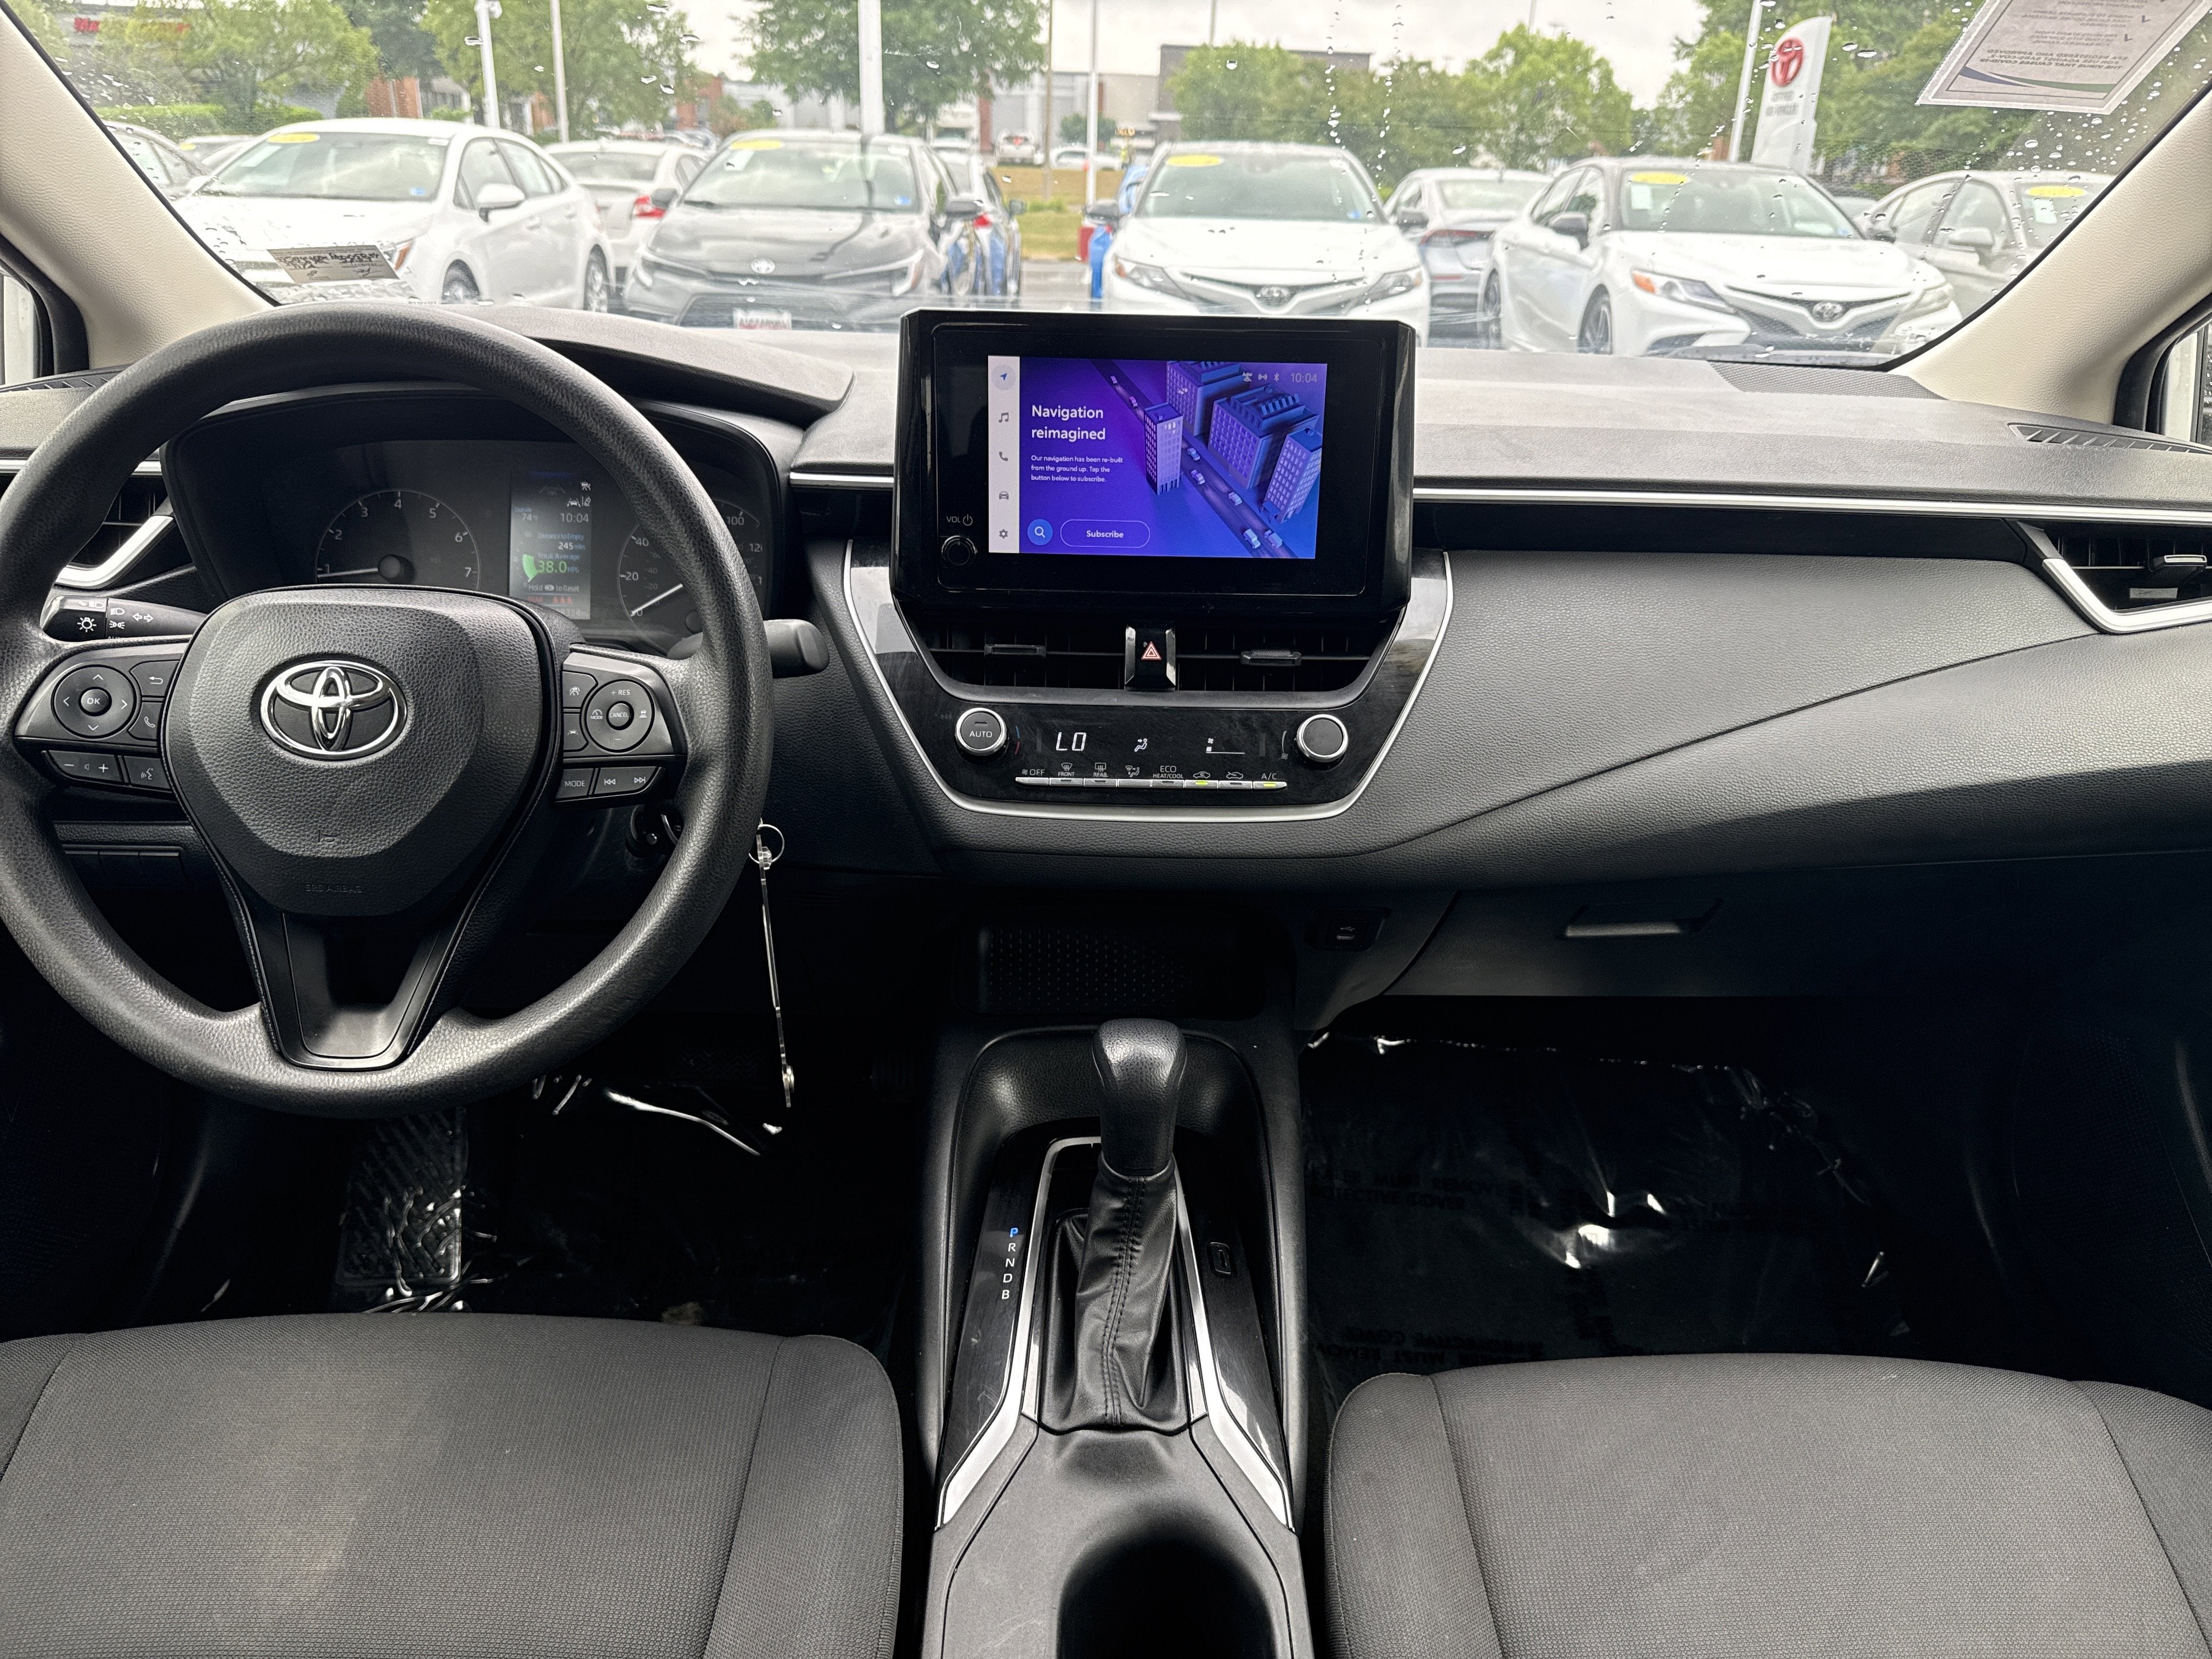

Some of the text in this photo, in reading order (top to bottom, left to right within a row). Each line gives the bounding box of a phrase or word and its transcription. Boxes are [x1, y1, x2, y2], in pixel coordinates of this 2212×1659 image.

[1290, 373, 1317, 382] 10:04
[1032, 405, 1104, 421] Navigation
[1031, 426, 1106, 442] reimagined
[394, 499, 402, 509] 4
[360, 508, 368, 517] 3
[429, 508, 437, 518] 5
[561, 513, 589, 523] 10:04
[726, 516, 744, 526] 100
[335, 529, 342, 540] 2
[455, 532, 463, 543] 6
[1086, 530, 1124, 538] Subscribe
[635, 538, 649, 546] 40
[325, 563, 330, 574] 1
[537, 559, 567, 573] 38.0
[465, 566, 472, 578] 7
[625, 572, 639, 580] 20
[1009, 1227, 1018, 1238] P
[1008, 1243, 1016, 1252] R
[1005, 1257, 1015, 1267] N
[1003, 1273, 1013, 1283] D
[1001, 1289, 1009, 1299] B
